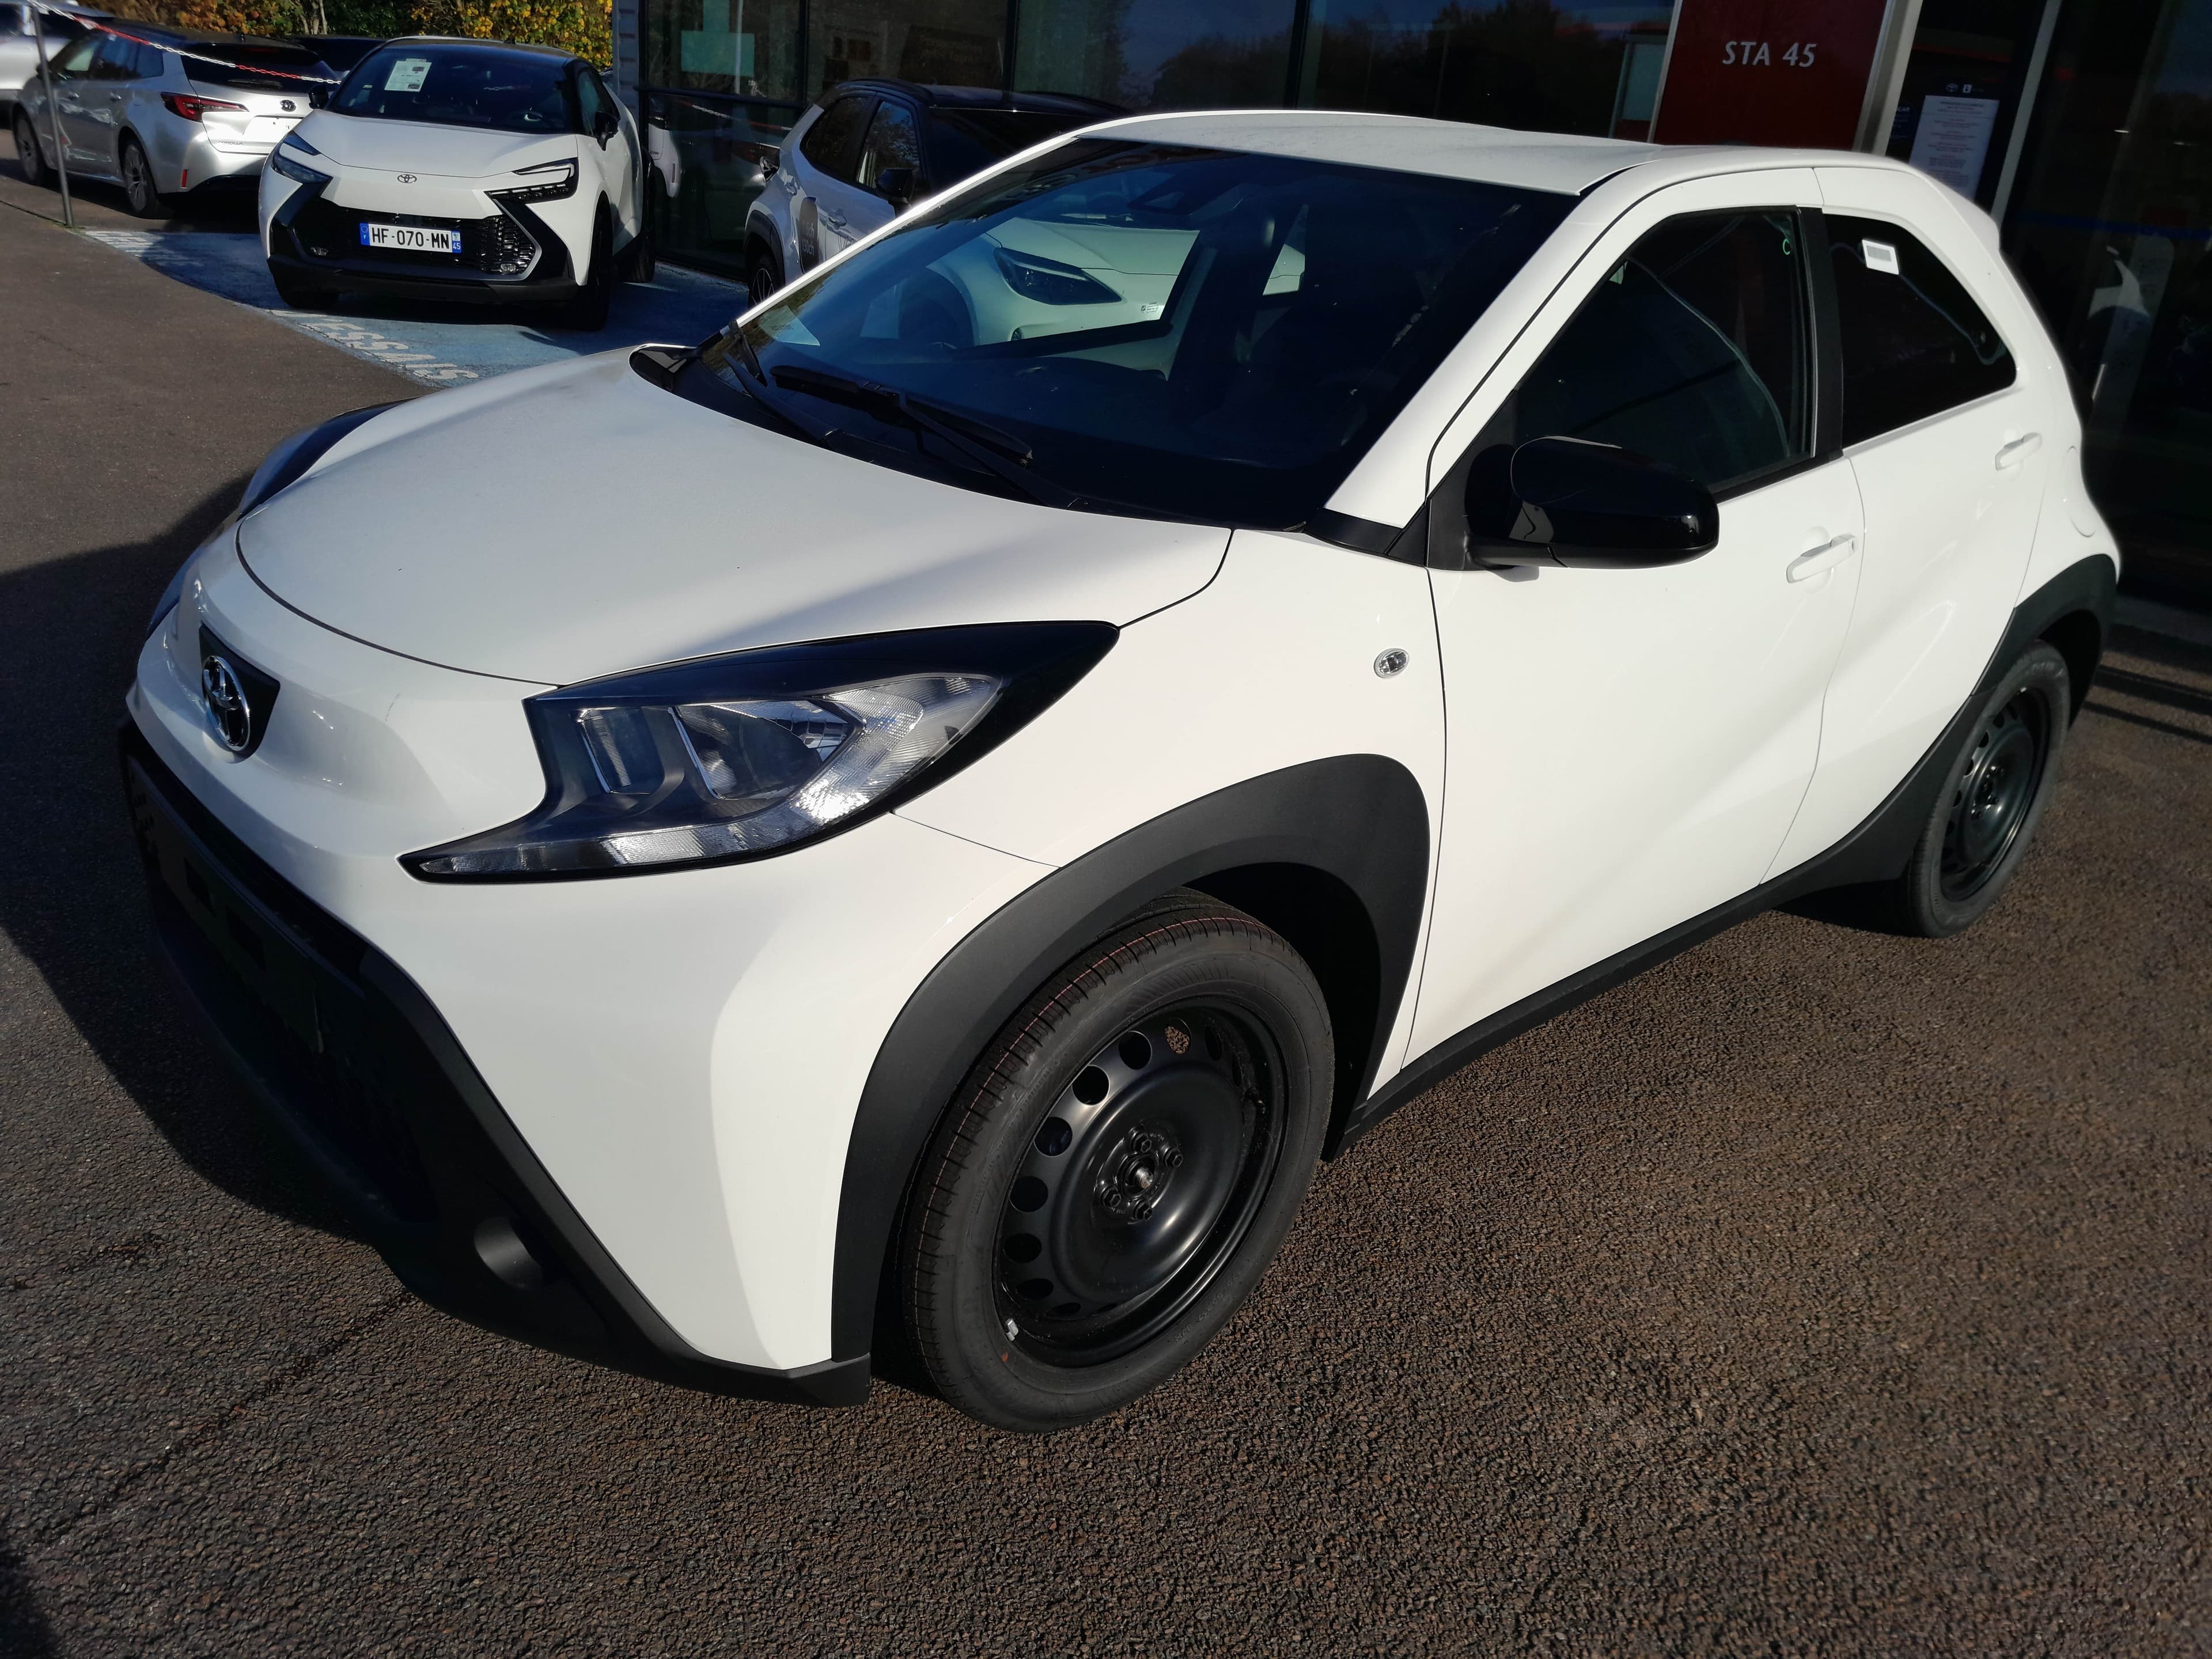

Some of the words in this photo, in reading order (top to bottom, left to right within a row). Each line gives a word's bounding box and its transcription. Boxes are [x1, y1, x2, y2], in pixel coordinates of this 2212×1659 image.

[1722, 41, 1770, 66] STA
[1782, 43, 1817, 67] 45
[372, 227, 450, 249] HF-070-MN
[453, 242, 461, 250] 45
